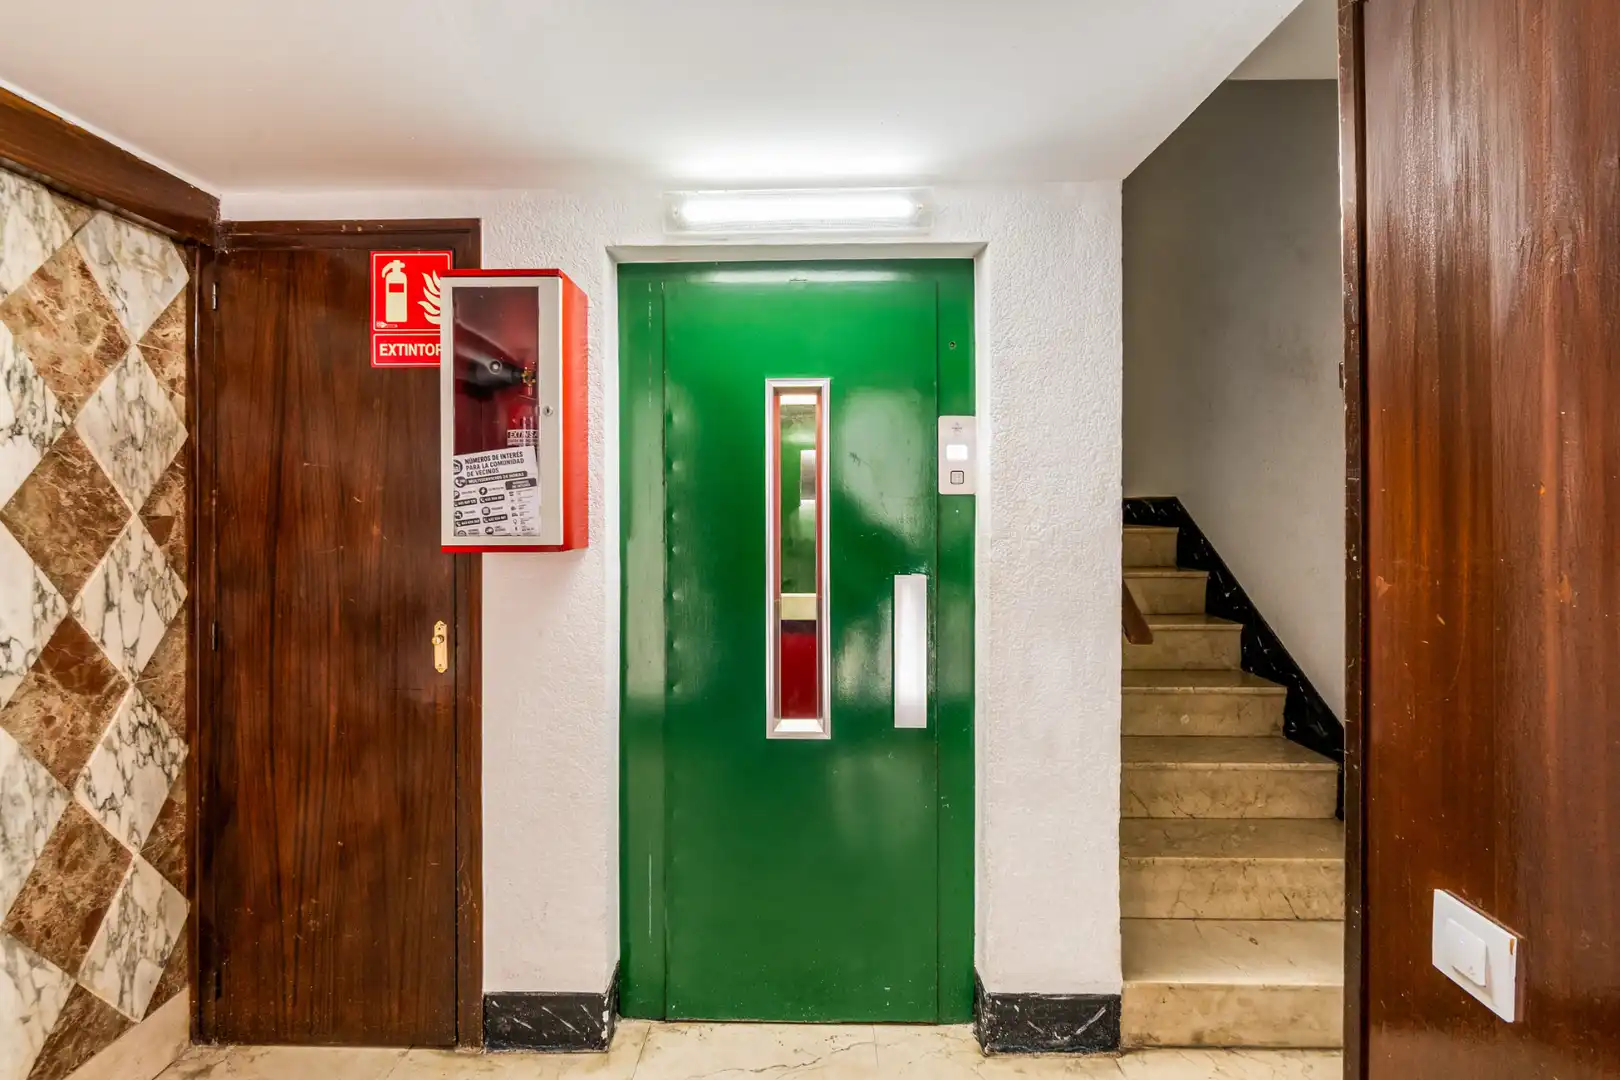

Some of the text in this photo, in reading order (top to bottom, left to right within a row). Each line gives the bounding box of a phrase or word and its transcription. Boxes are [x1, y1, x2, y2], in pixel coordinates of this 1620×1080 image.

[465, 455, 490, 464] NÚMEROS
[500, 451, 523, 459] INTERÉS
[490, 458, 524, 467] COMUNIDAD
[475, 468, 499, 476] VECINOS
